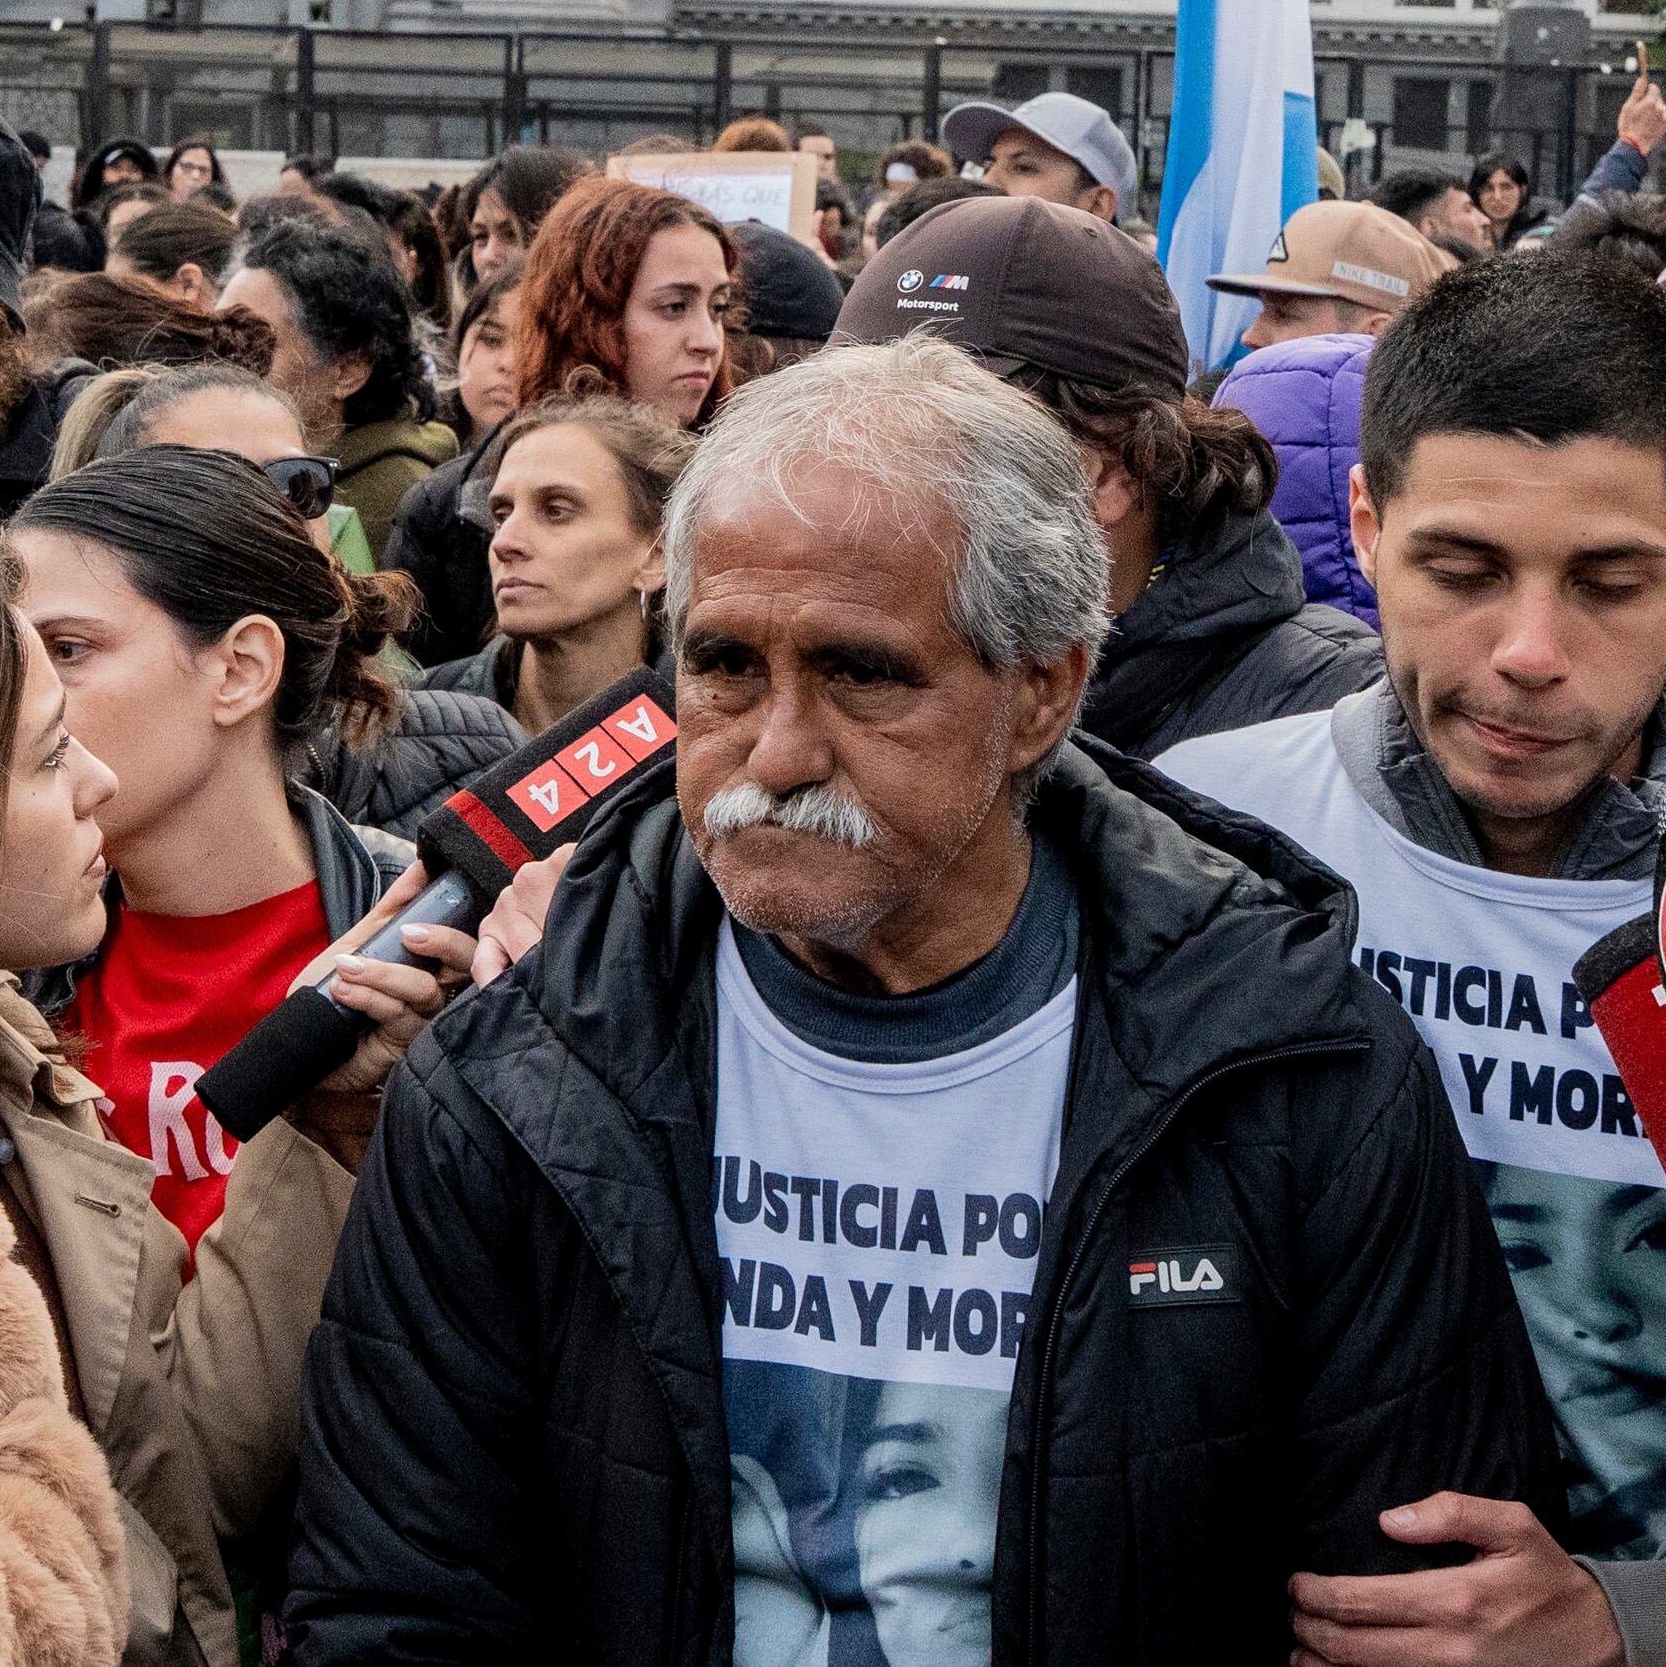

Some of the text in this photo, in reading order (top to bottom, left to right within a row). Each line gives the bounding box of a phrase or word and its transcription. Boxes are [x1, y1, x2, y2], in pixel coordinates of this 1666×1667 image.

[1338, 264, 1367, 282] NIKE
[896, 298, 960, 312] Motorsport
[527, 705, 658, 816] A24
[1457, 1052, 1650, 1139] Y MOR
[1129, 1258, 1224, 1295] FILA
[847, 1278, 894, 1348] Y
